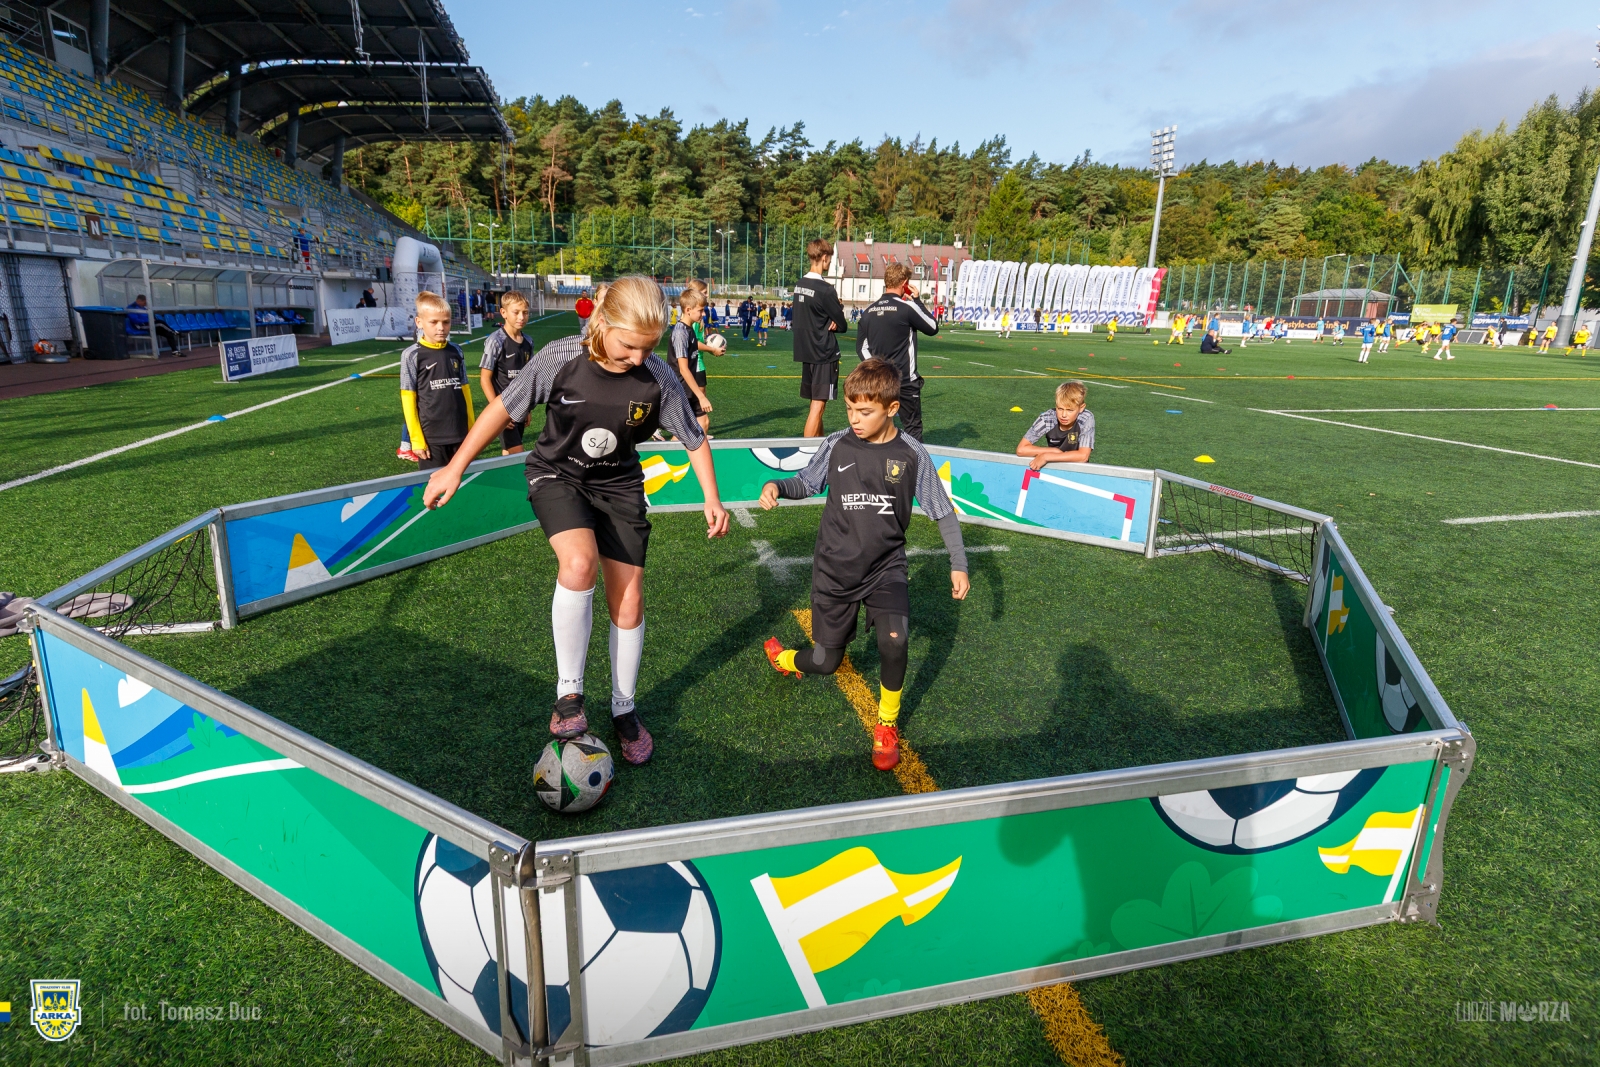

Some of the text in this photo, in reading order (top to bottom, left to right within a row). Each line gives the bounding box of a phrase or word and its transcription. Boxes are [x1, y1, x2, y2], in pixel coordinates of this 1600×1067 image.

[91, 220, 100, 235] N
[252, 344, 276, 356] BEEP TEST
